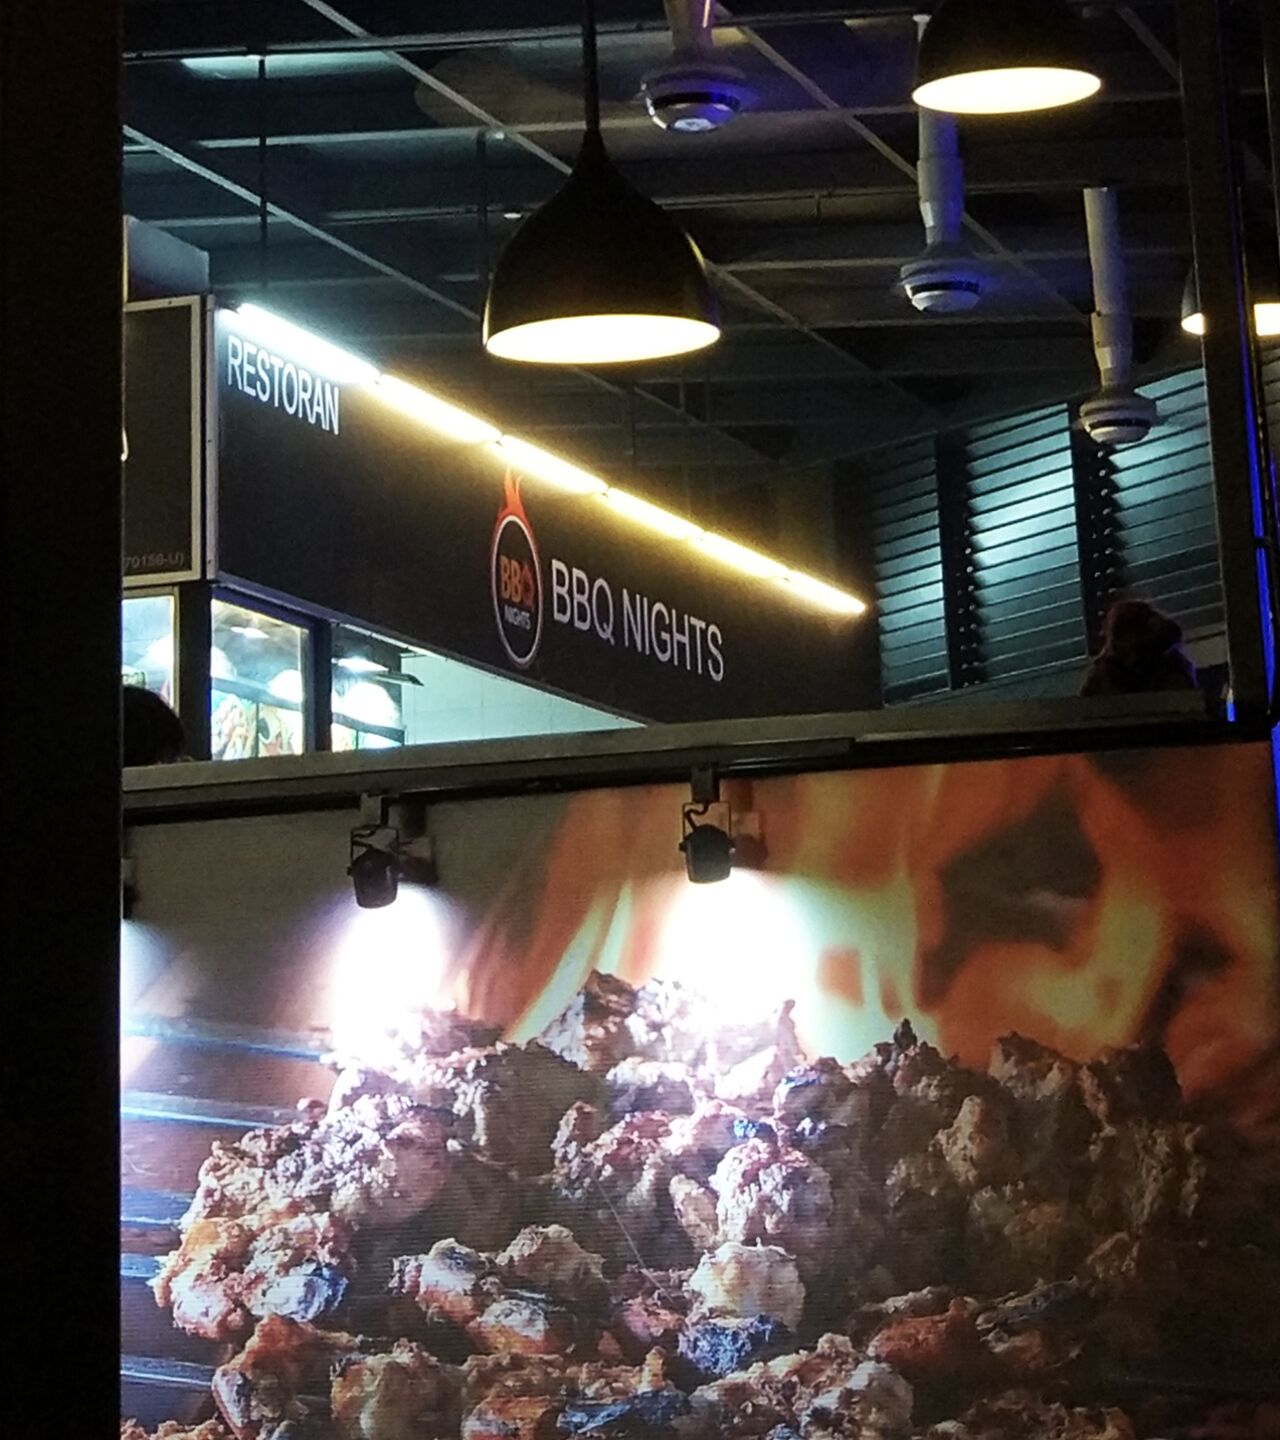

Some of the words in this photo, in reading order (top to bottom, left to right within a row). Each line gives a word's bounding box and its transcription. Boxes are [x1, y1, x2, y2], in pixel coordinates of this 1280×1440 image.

[227, 333, 340, 436] RESTORAN
[500, 555, 535, 612] BBQ
[551, 558, 615, 646] BBQ
[622, 587, 724, 682] NIGHTS
